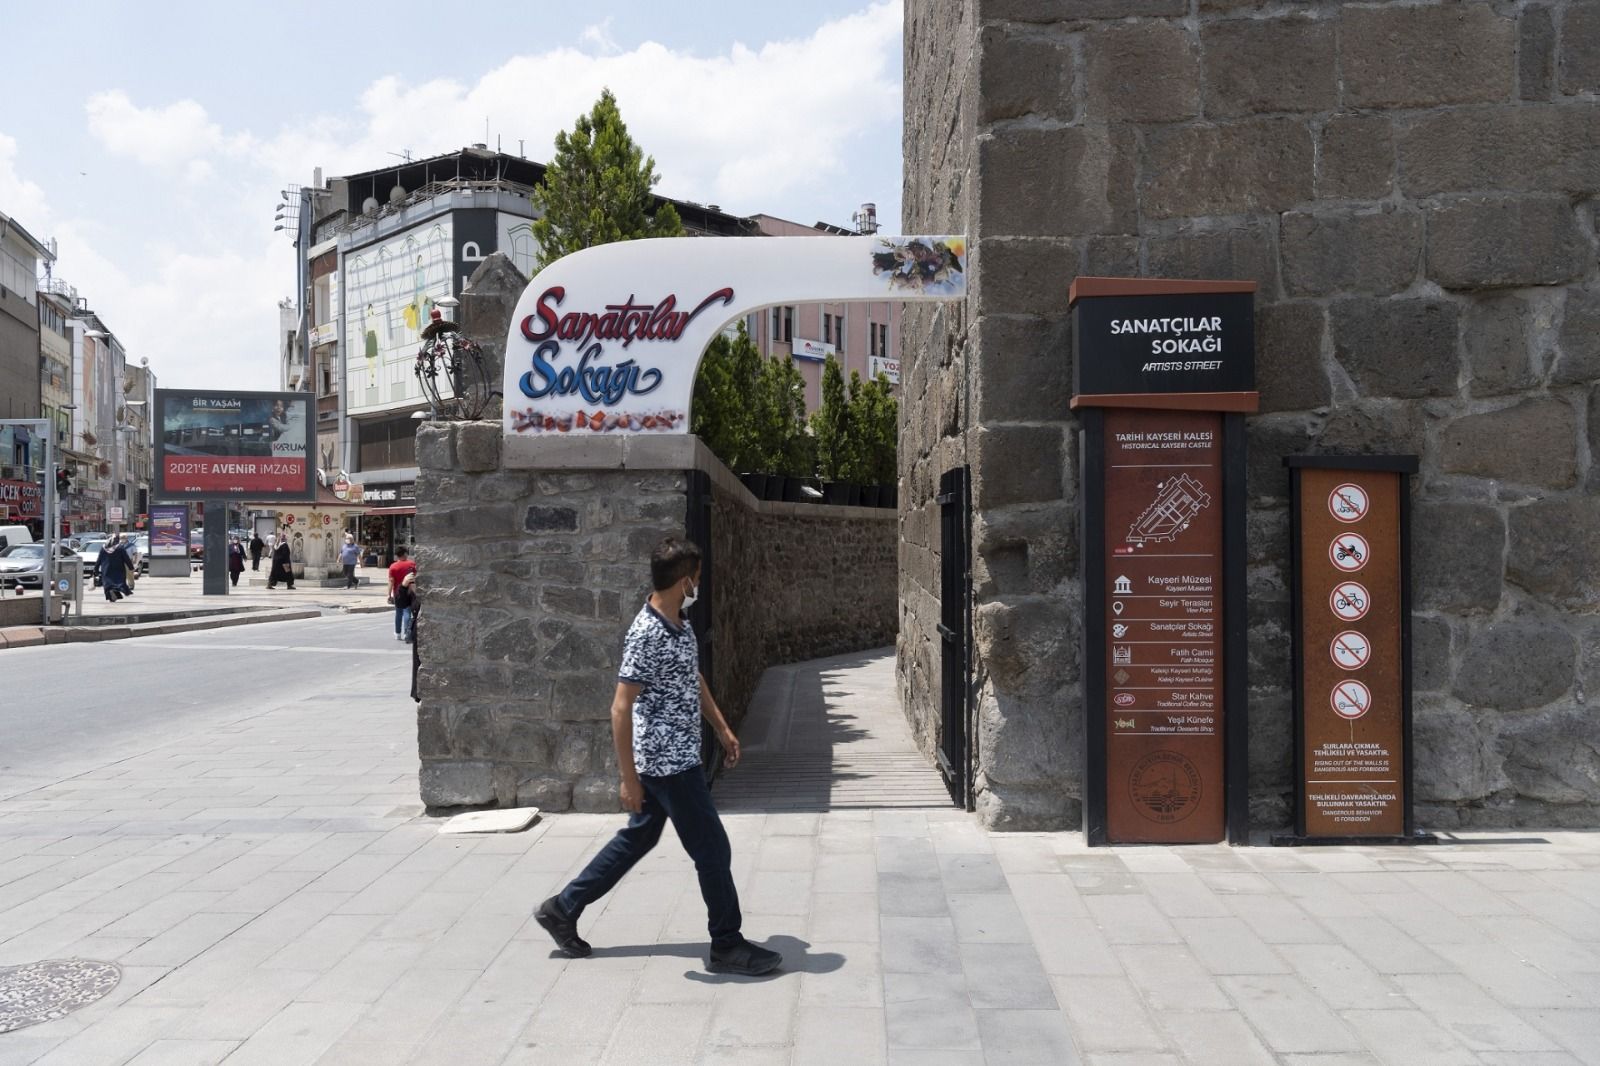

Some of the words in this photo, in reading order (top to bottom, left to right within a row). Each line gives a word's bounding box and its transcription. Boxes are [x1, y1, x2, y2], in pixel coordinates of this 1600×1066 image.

[520, 285, 734, 348] Sanatçılar
[1110, 316, 1222, 337] SANATÇILAR
[1151, 334, 1222, 355] SOKAĞI
[1142, 361, 1183, 372] ARTISTS
[1184, 360, 1223, 371] STREET
[519, 340, 663, 405] Sokağı
[210, 399, 241, 409] YAŞAM
[1115, 432, 1144, 441] TARİHİ
[1146, 430, 1181, 441] KAYSERİ
[1183, 430, 1213, 440] KALESİ
[273, 443, 306, 452] KARUM
[170, 463, 208, 474] 2021'E
[1148, 576, 1179, 586] Kayseri
[1181, 575, 1212, 584] Müzesi
[1160, 600, 1179, 608] Seyir
[1172, 692, 1187, 701] Star
